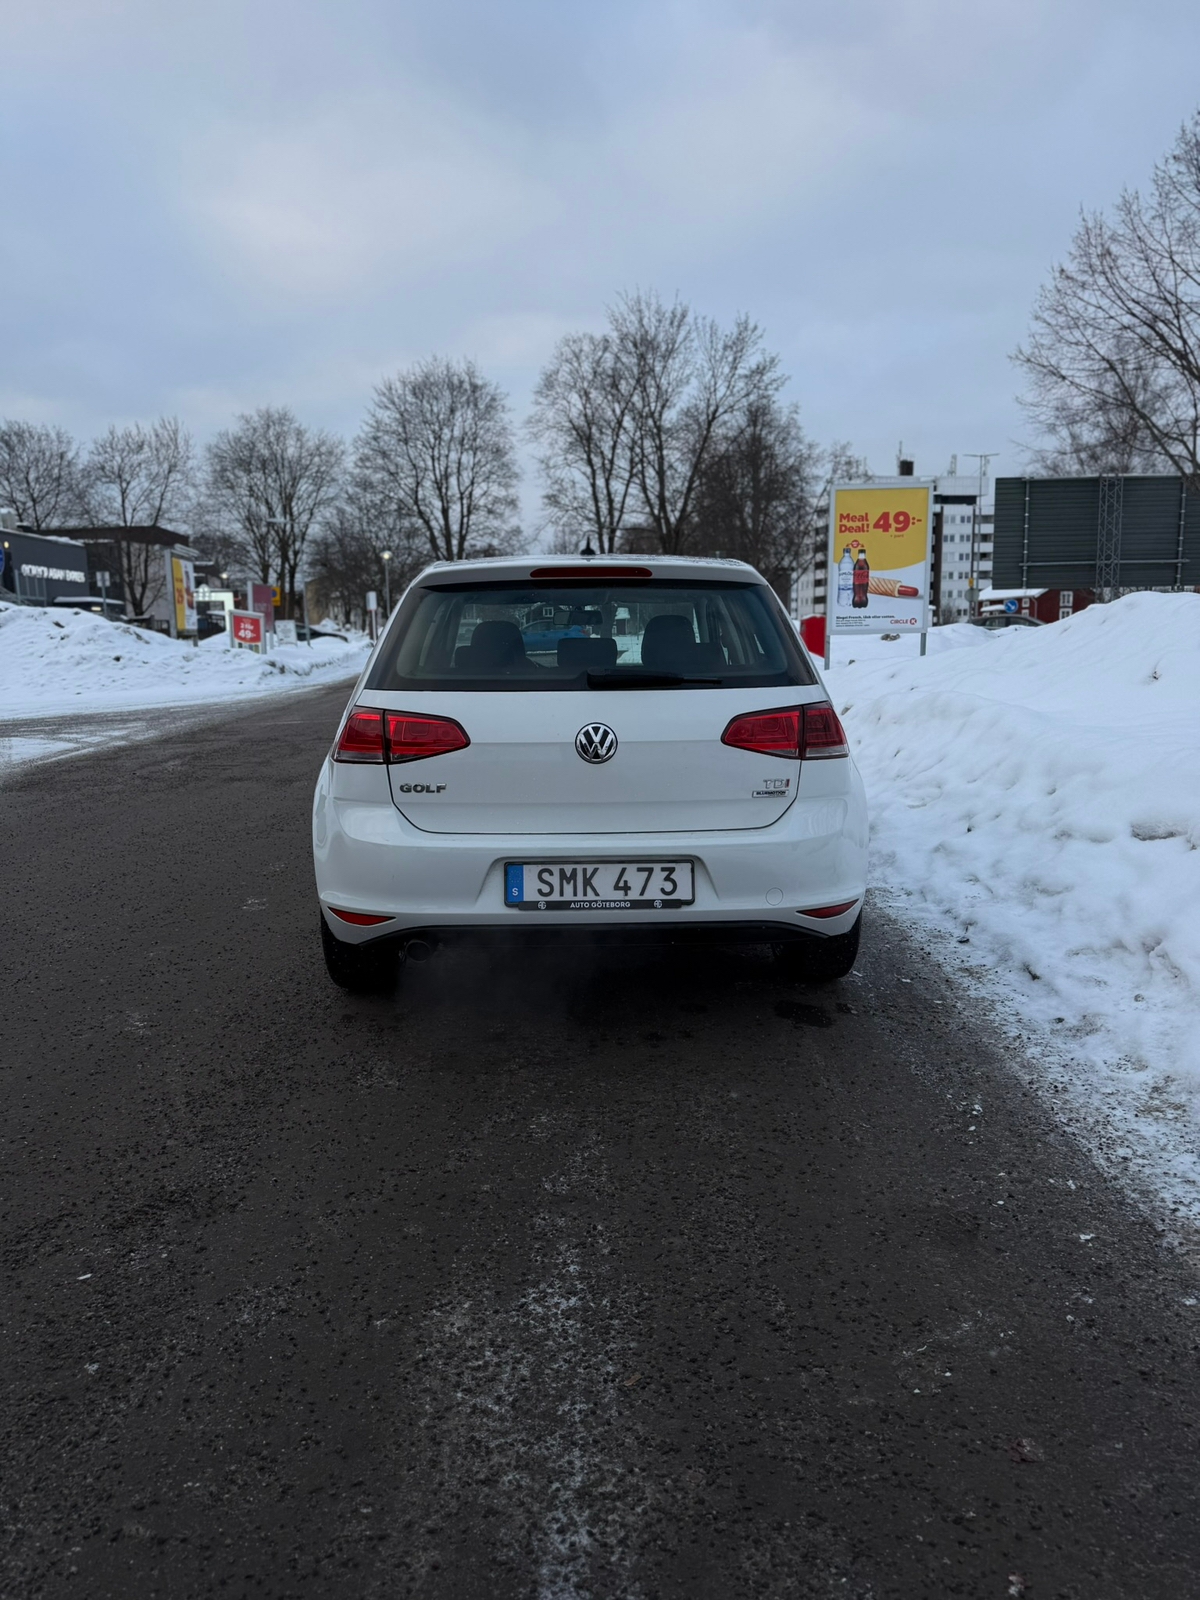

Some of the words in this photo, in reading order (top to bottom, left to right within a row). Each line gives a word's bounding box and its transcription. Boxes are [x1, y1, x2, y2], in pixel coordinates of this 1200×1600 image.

[839, 512, 869, 523] Meal
[873, 511, 922, 533] 49:-
[839, 523, 870, 534] Deal!
[399, 783, 447, 794] GOLF
[763, 778, 790, 789] TDI
[537, 868, 600, 897] SMK
[613, 867, 678, 897] 473
[512, 888, 519, 896] S
[591, 900, 631, 909] GÖTEBORG
